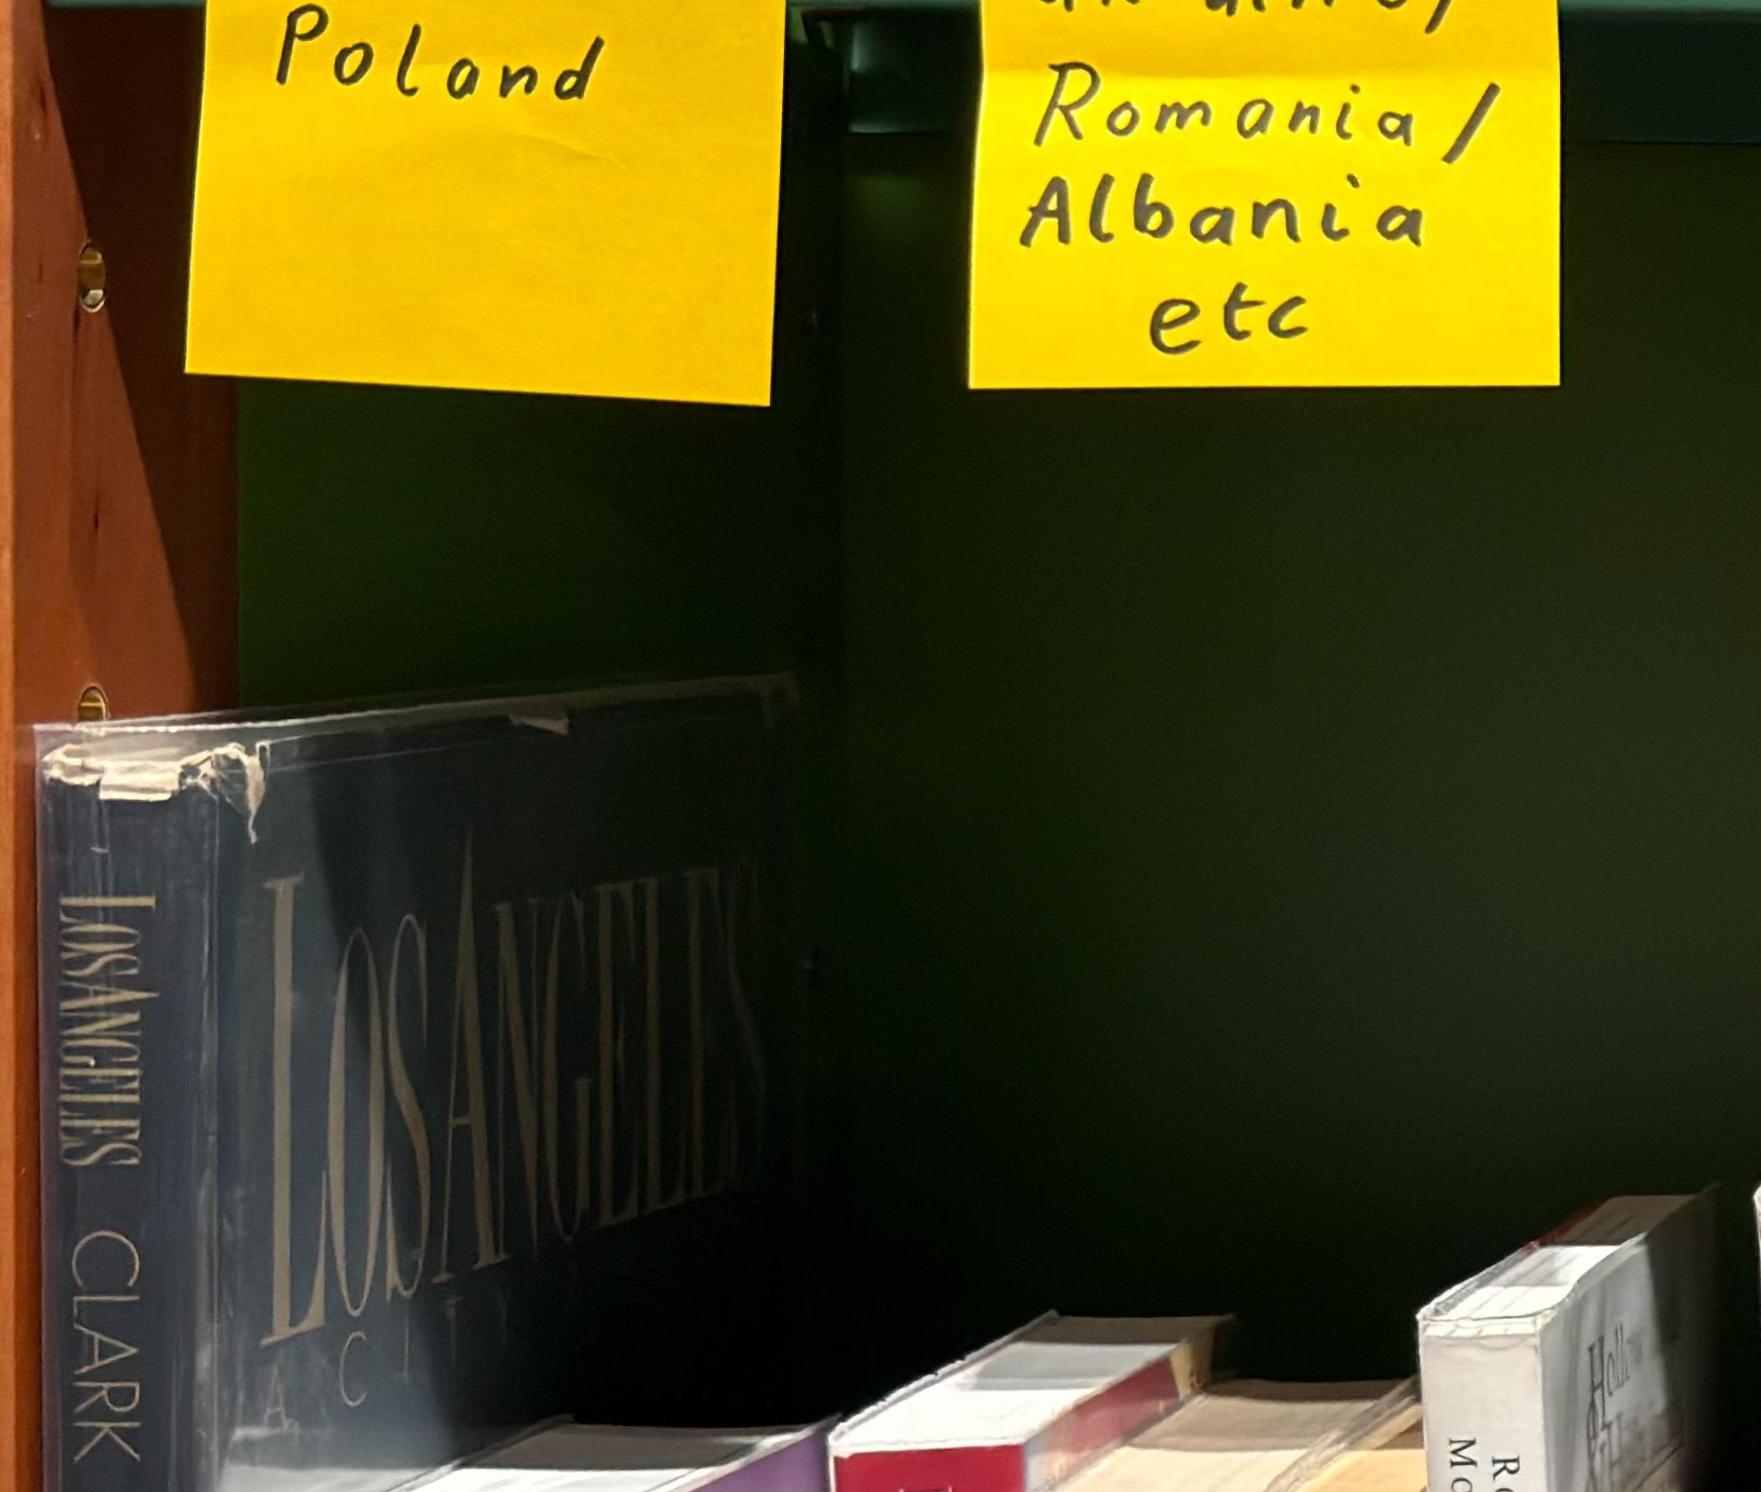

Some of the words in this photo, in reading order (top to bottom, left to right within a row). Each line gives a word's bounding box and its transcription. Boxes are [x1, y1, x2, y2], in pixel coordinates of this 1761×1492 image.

[275, 4, 604, 104] Poland
[1033, 60, 1501, 166] Romania/
[1020, 173, 1424, 250] Albania
[1149, 279, 1311, 356] etc
[70, 1229, 142, 1466] CLARK
